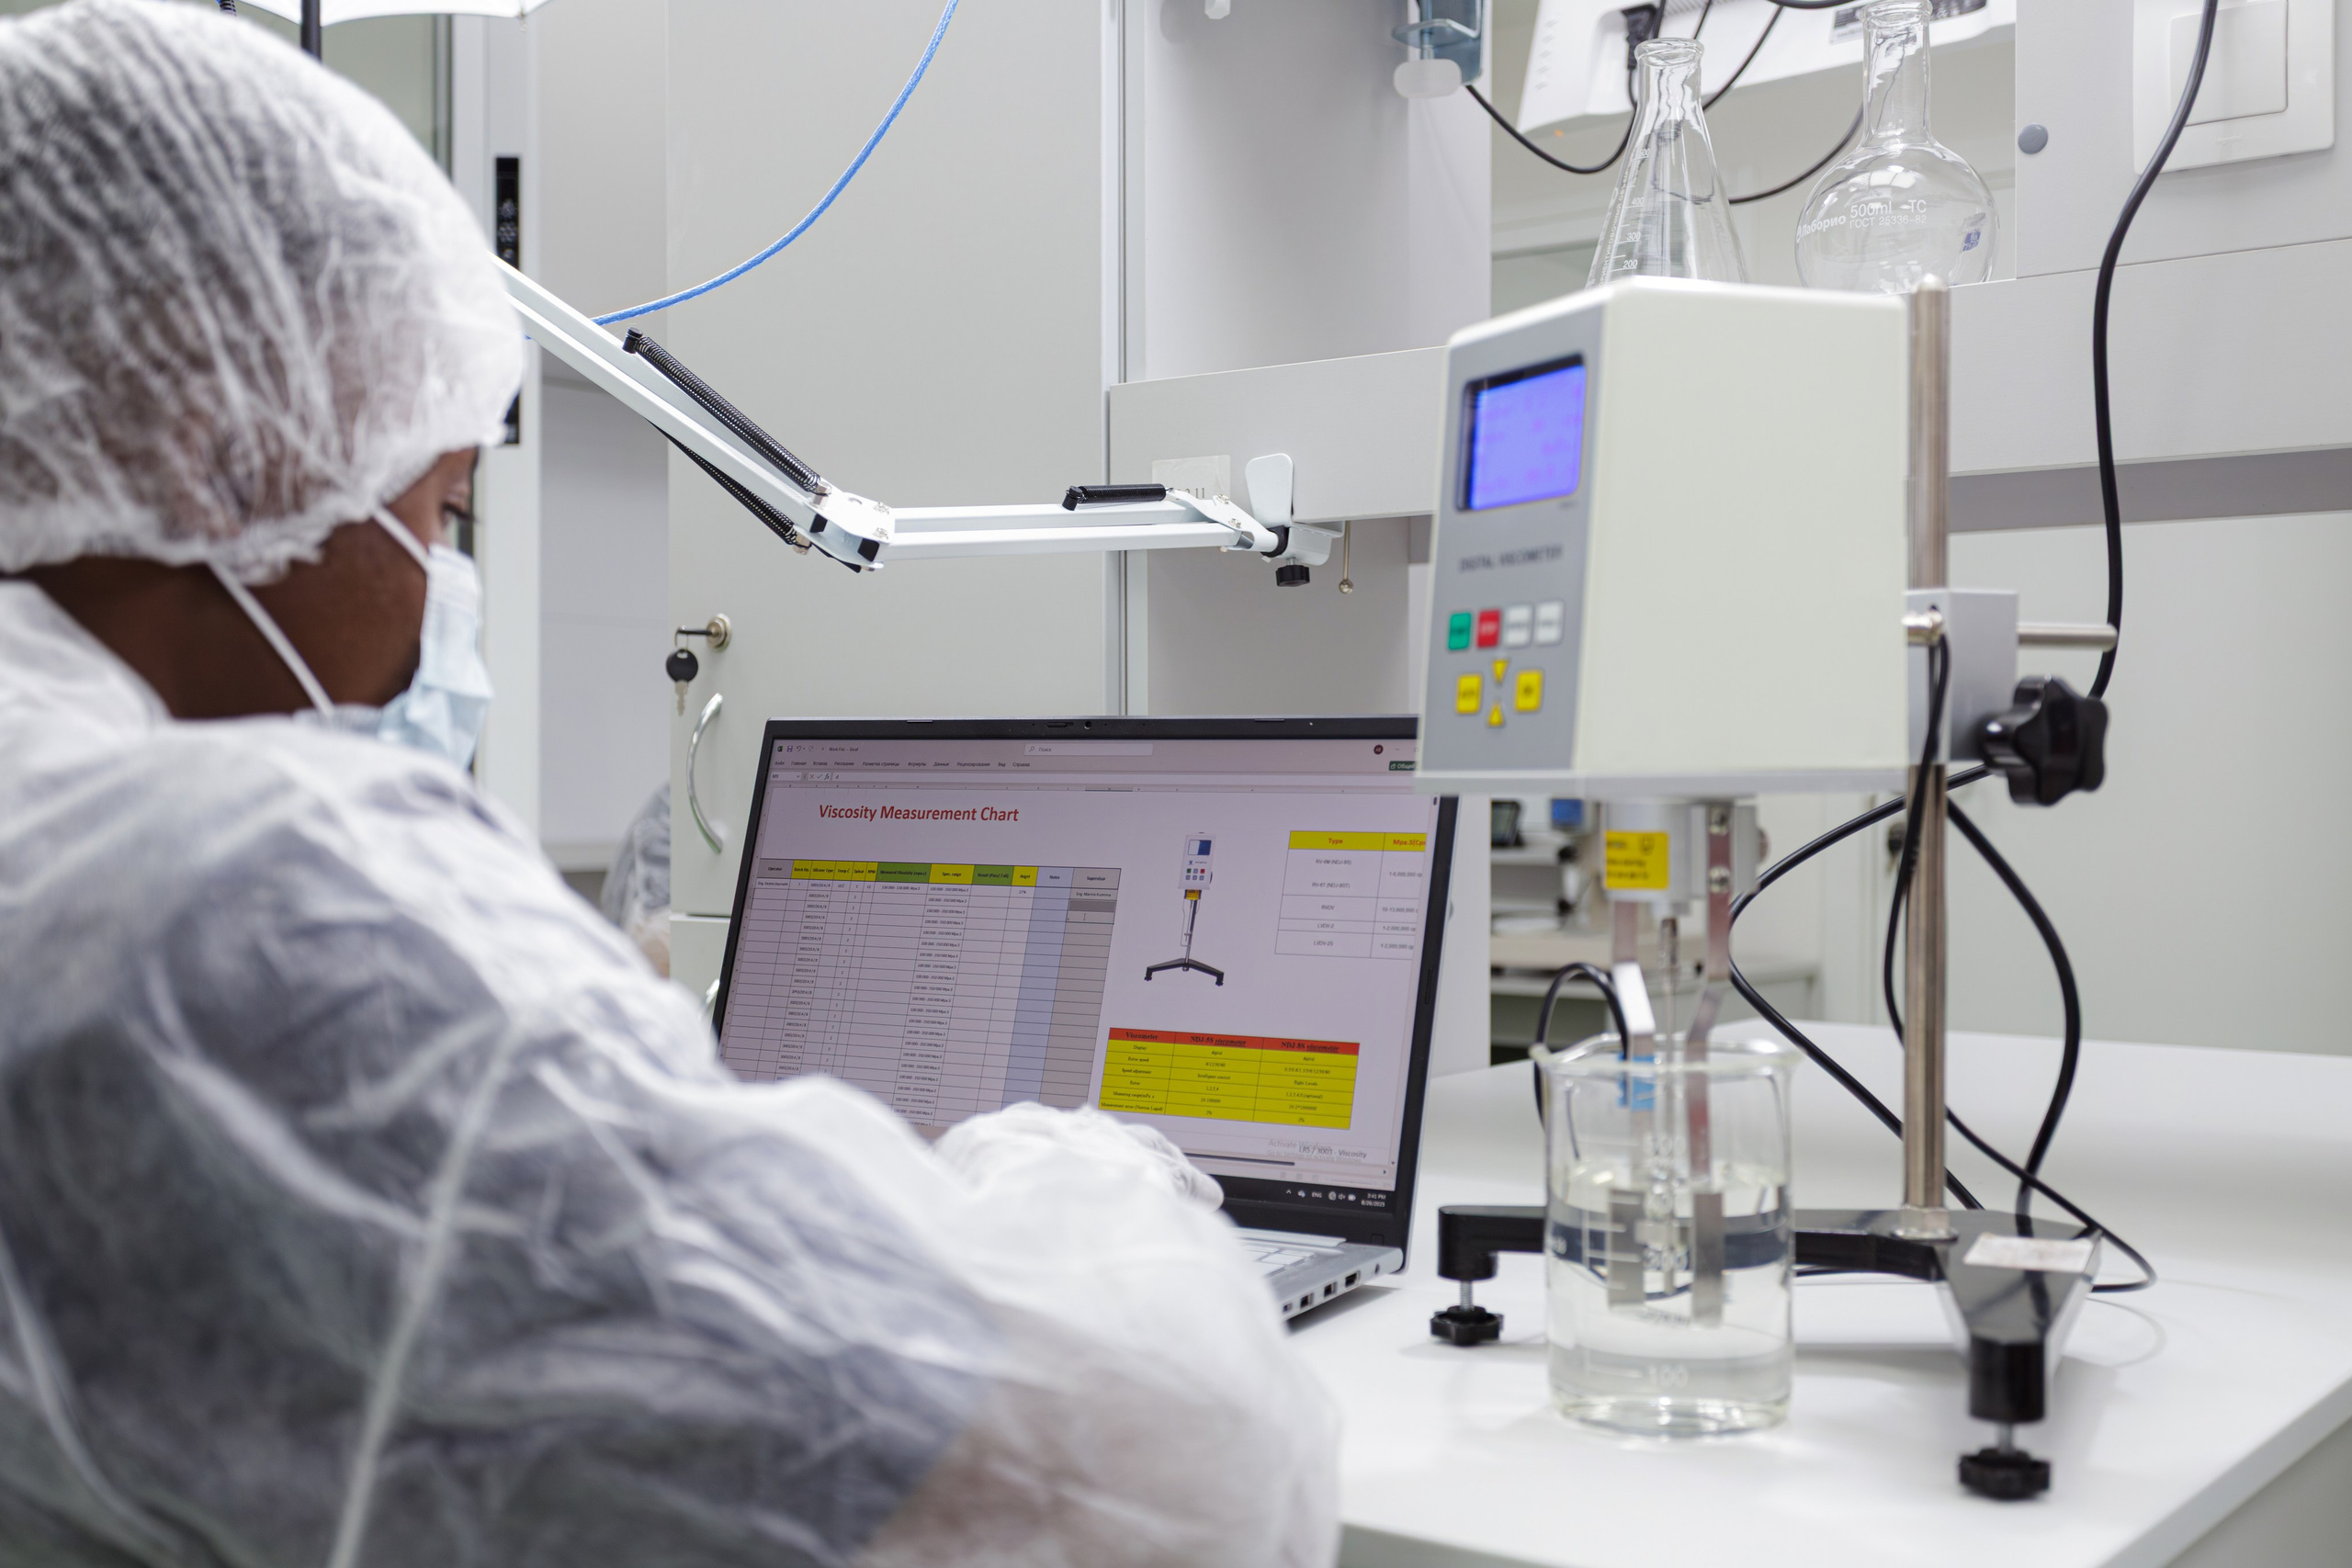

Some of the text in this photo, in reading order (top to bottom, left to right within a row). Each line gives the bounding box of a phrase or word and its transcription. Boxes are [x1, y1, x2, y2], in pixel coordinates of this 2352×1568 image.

[1631, 197, 1645, 206] 400
[1850, 199, 1928, 219] 500ml TC
[1849, 217, 1875, 229] ГОСТ
[1626, 231, 1641, 241] 300
[1623, 259, 1638, 268] 200
[819, 805, 1019, 822] Viscosity Measurement Chart
[1125, 1032, 1159, 1040] Viscometer
[1339, 1149, 1367, 1159] Viscosity
